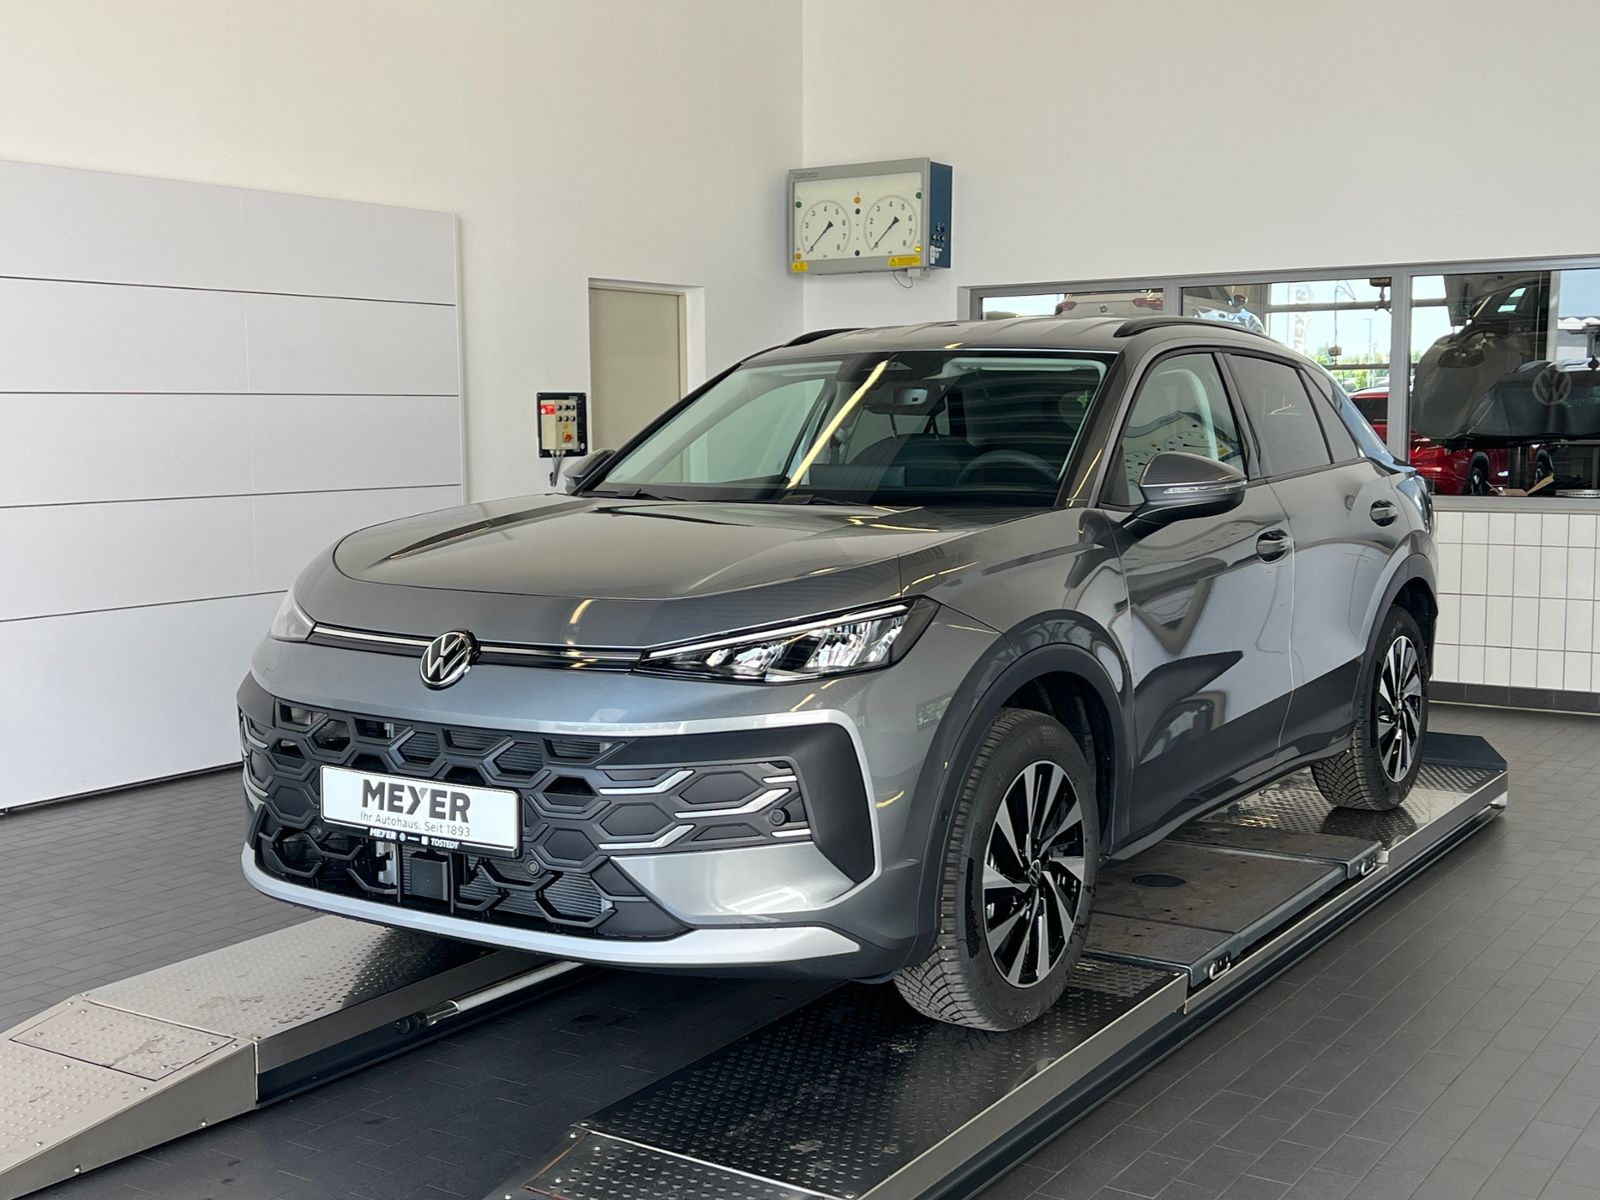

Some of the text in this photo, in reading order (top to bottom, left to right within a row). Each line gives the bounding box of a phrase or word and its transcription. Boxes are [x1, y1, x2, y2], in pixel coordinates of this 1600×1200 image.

[361, 779, 471, 823] MEYER
[360, 811, 471, 838] Ihr Autohaus. Seit 1893
[369, 827, 397, 841] MEYER
[430, 837, 459, 849] TOSTEDT
